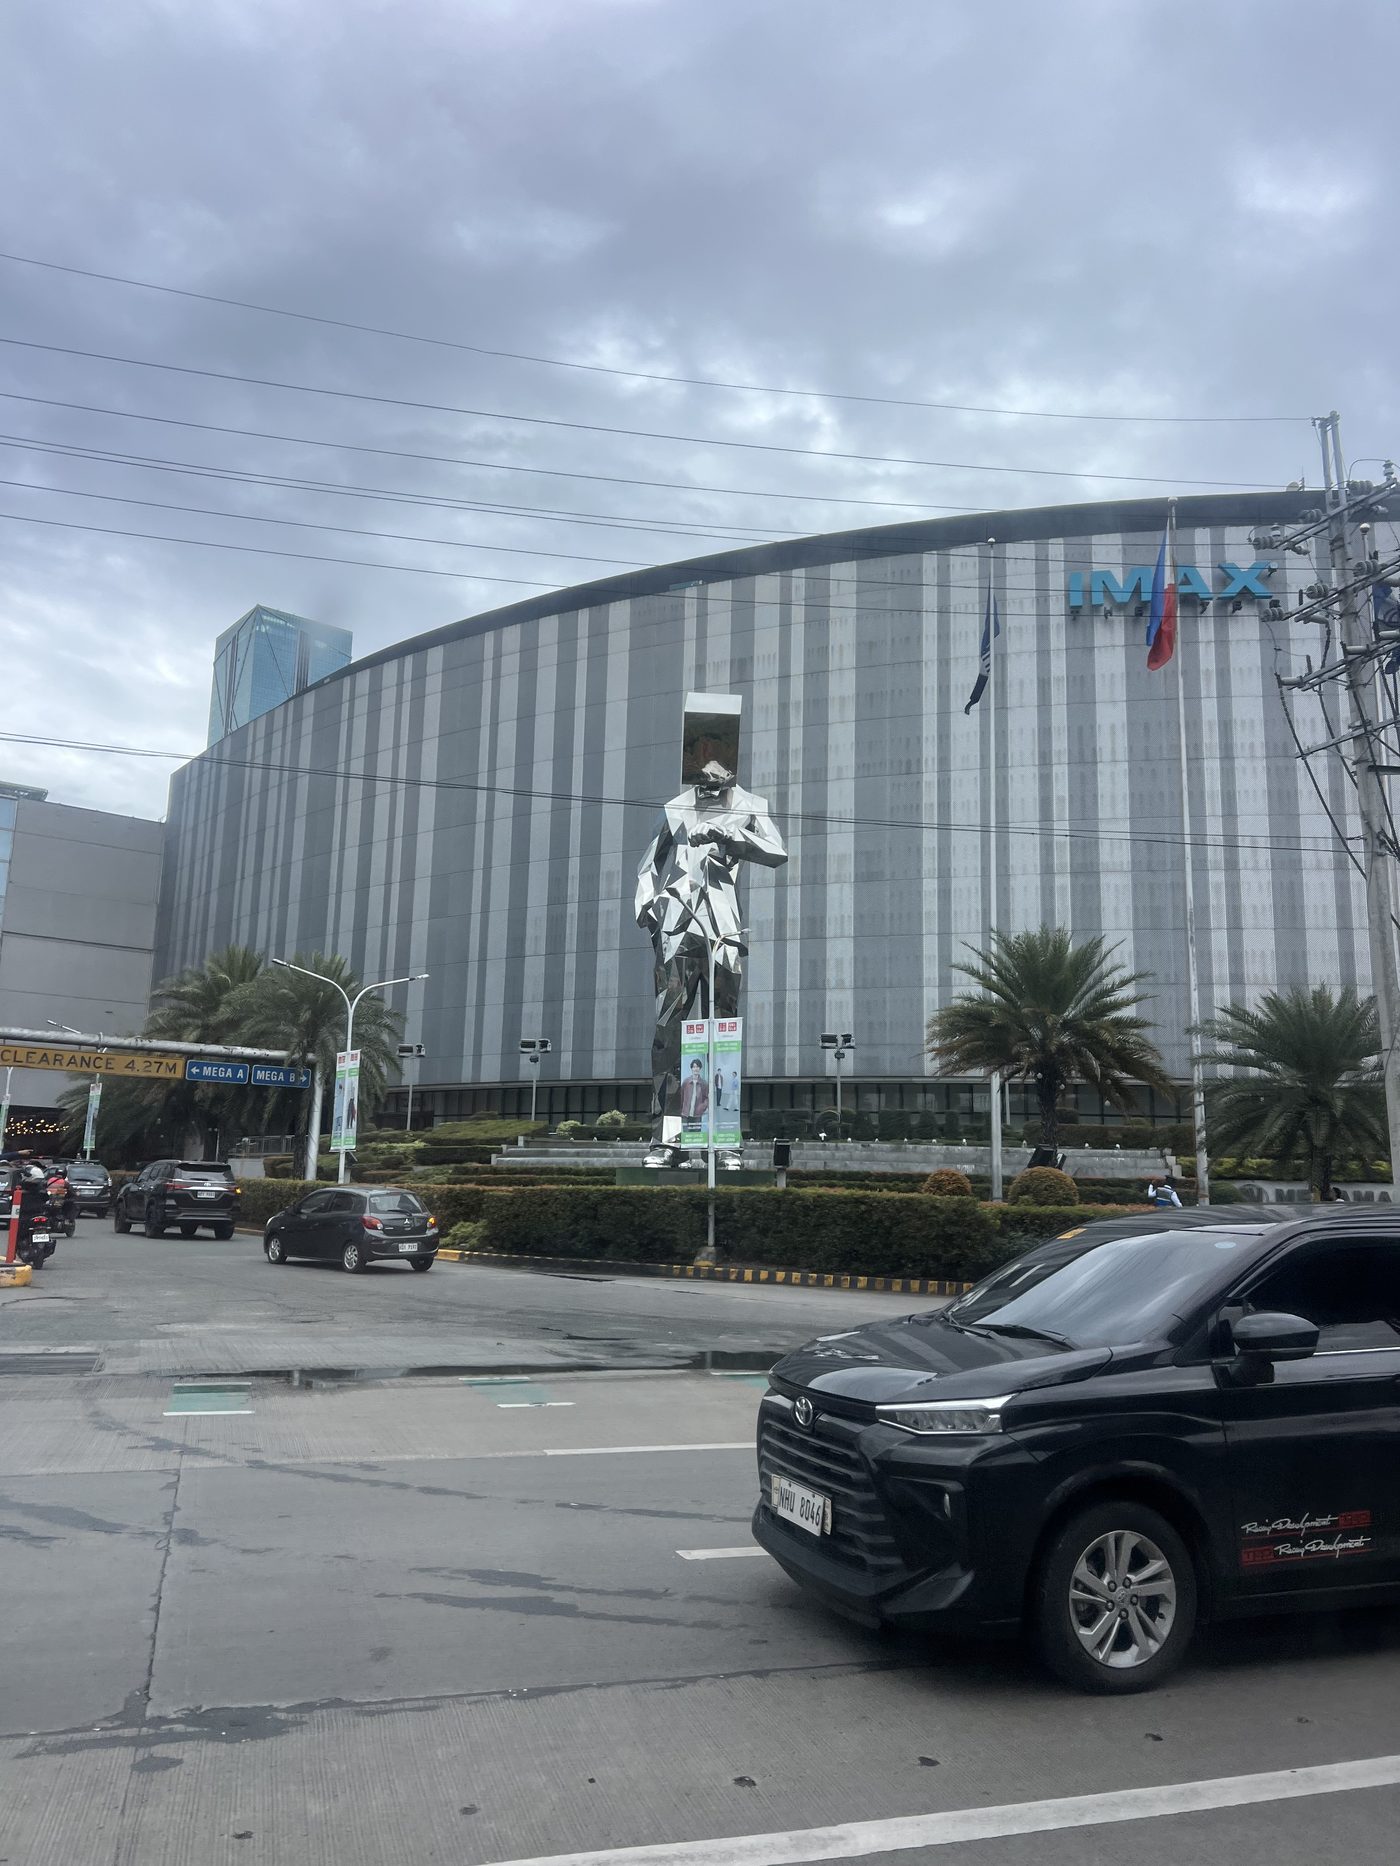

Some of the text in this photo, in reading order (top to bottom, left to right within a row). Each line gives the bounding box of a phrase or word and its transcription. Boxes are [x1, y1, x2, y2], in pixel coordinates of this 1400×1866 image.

[1068, 560, 1274, 608] IMAX
[0, 1049, 177, 1075] CLEARANCE 4.27M
[202, 1066, 244, 1079] MEGA A
[256, 1070, 296, 1082] MEGA B
[779, 1486, 796, 1513] NHU
[800, 1497, 821, 1526] 8046
